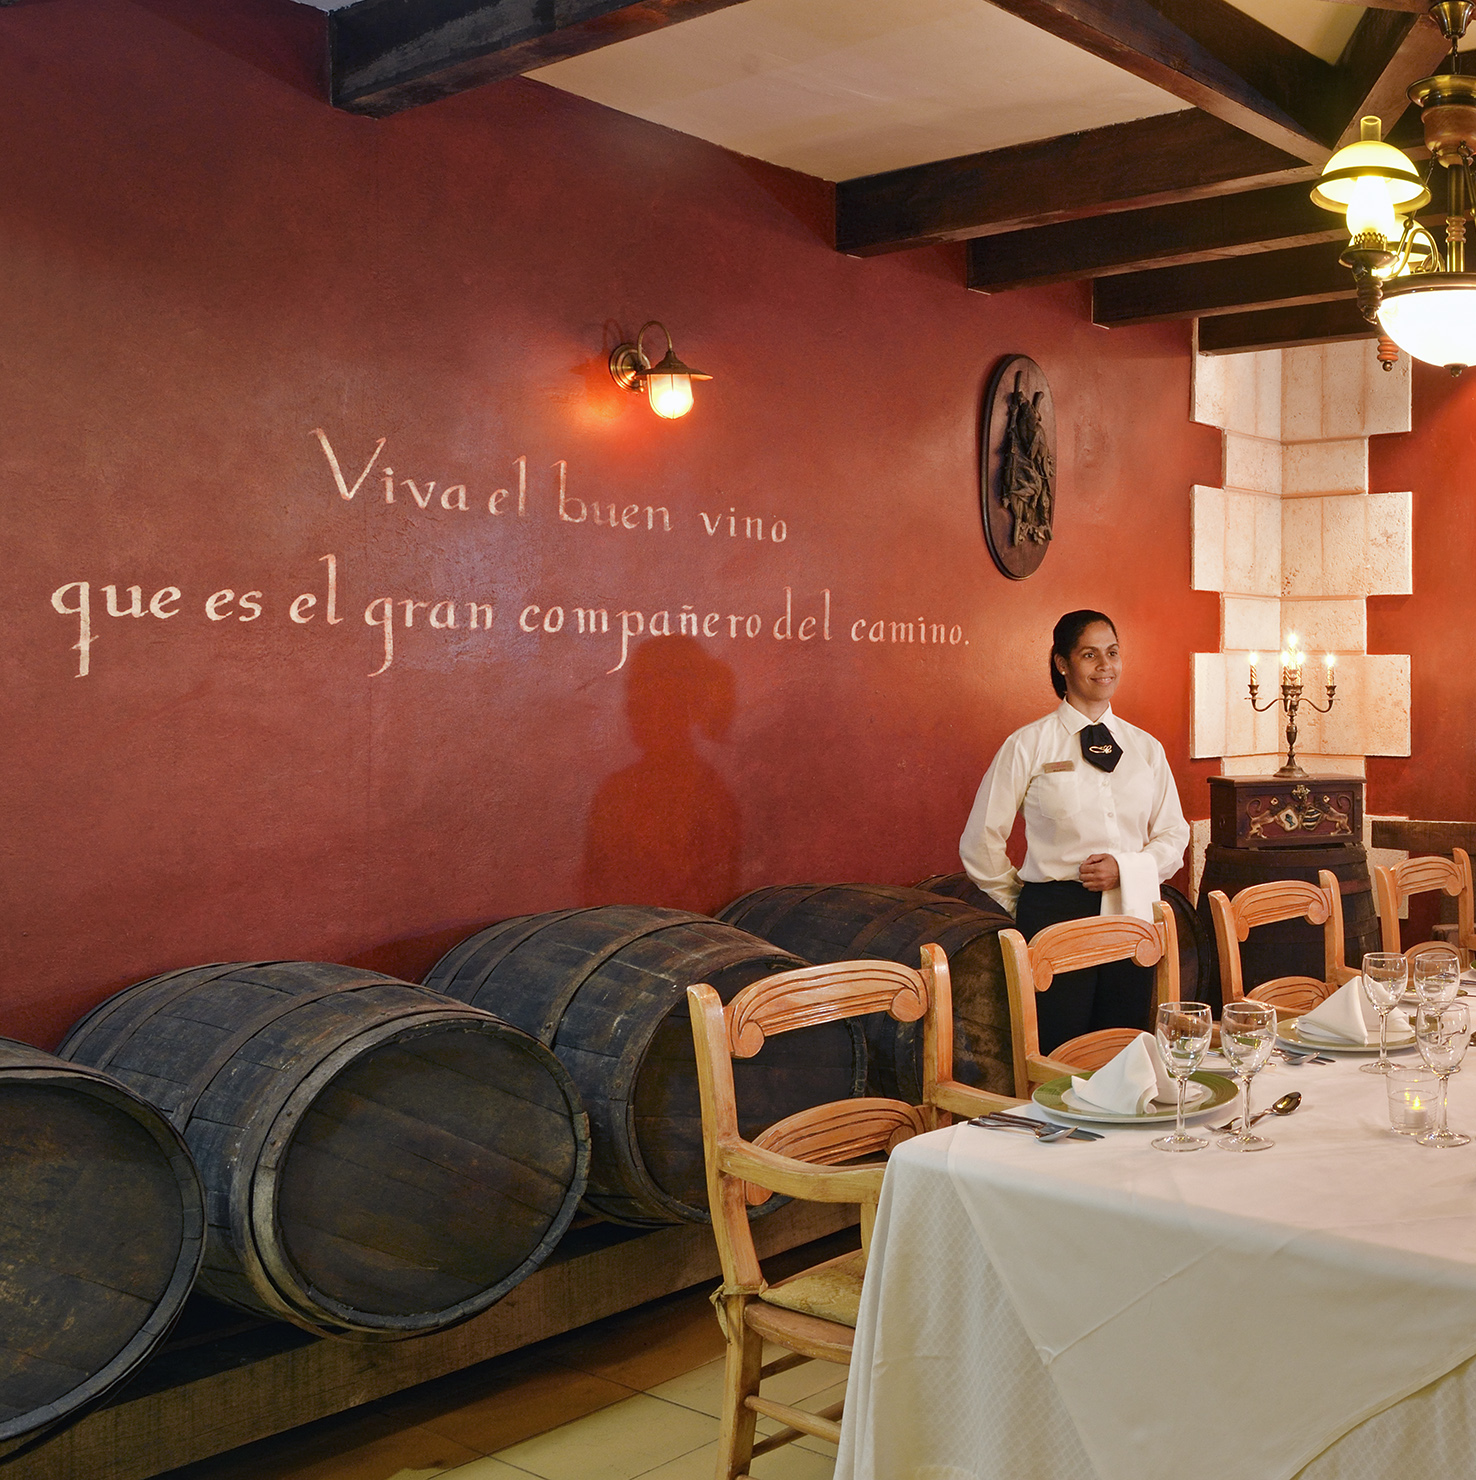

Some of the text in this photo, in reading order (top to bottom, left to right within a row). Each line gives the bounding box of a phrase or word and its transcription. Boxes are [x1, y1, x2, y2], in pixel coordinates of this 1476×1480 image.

[308, 427, 787, 543] Viva el buen vino
[50, 553, 970, 678] que es el gran compañero del camino.
